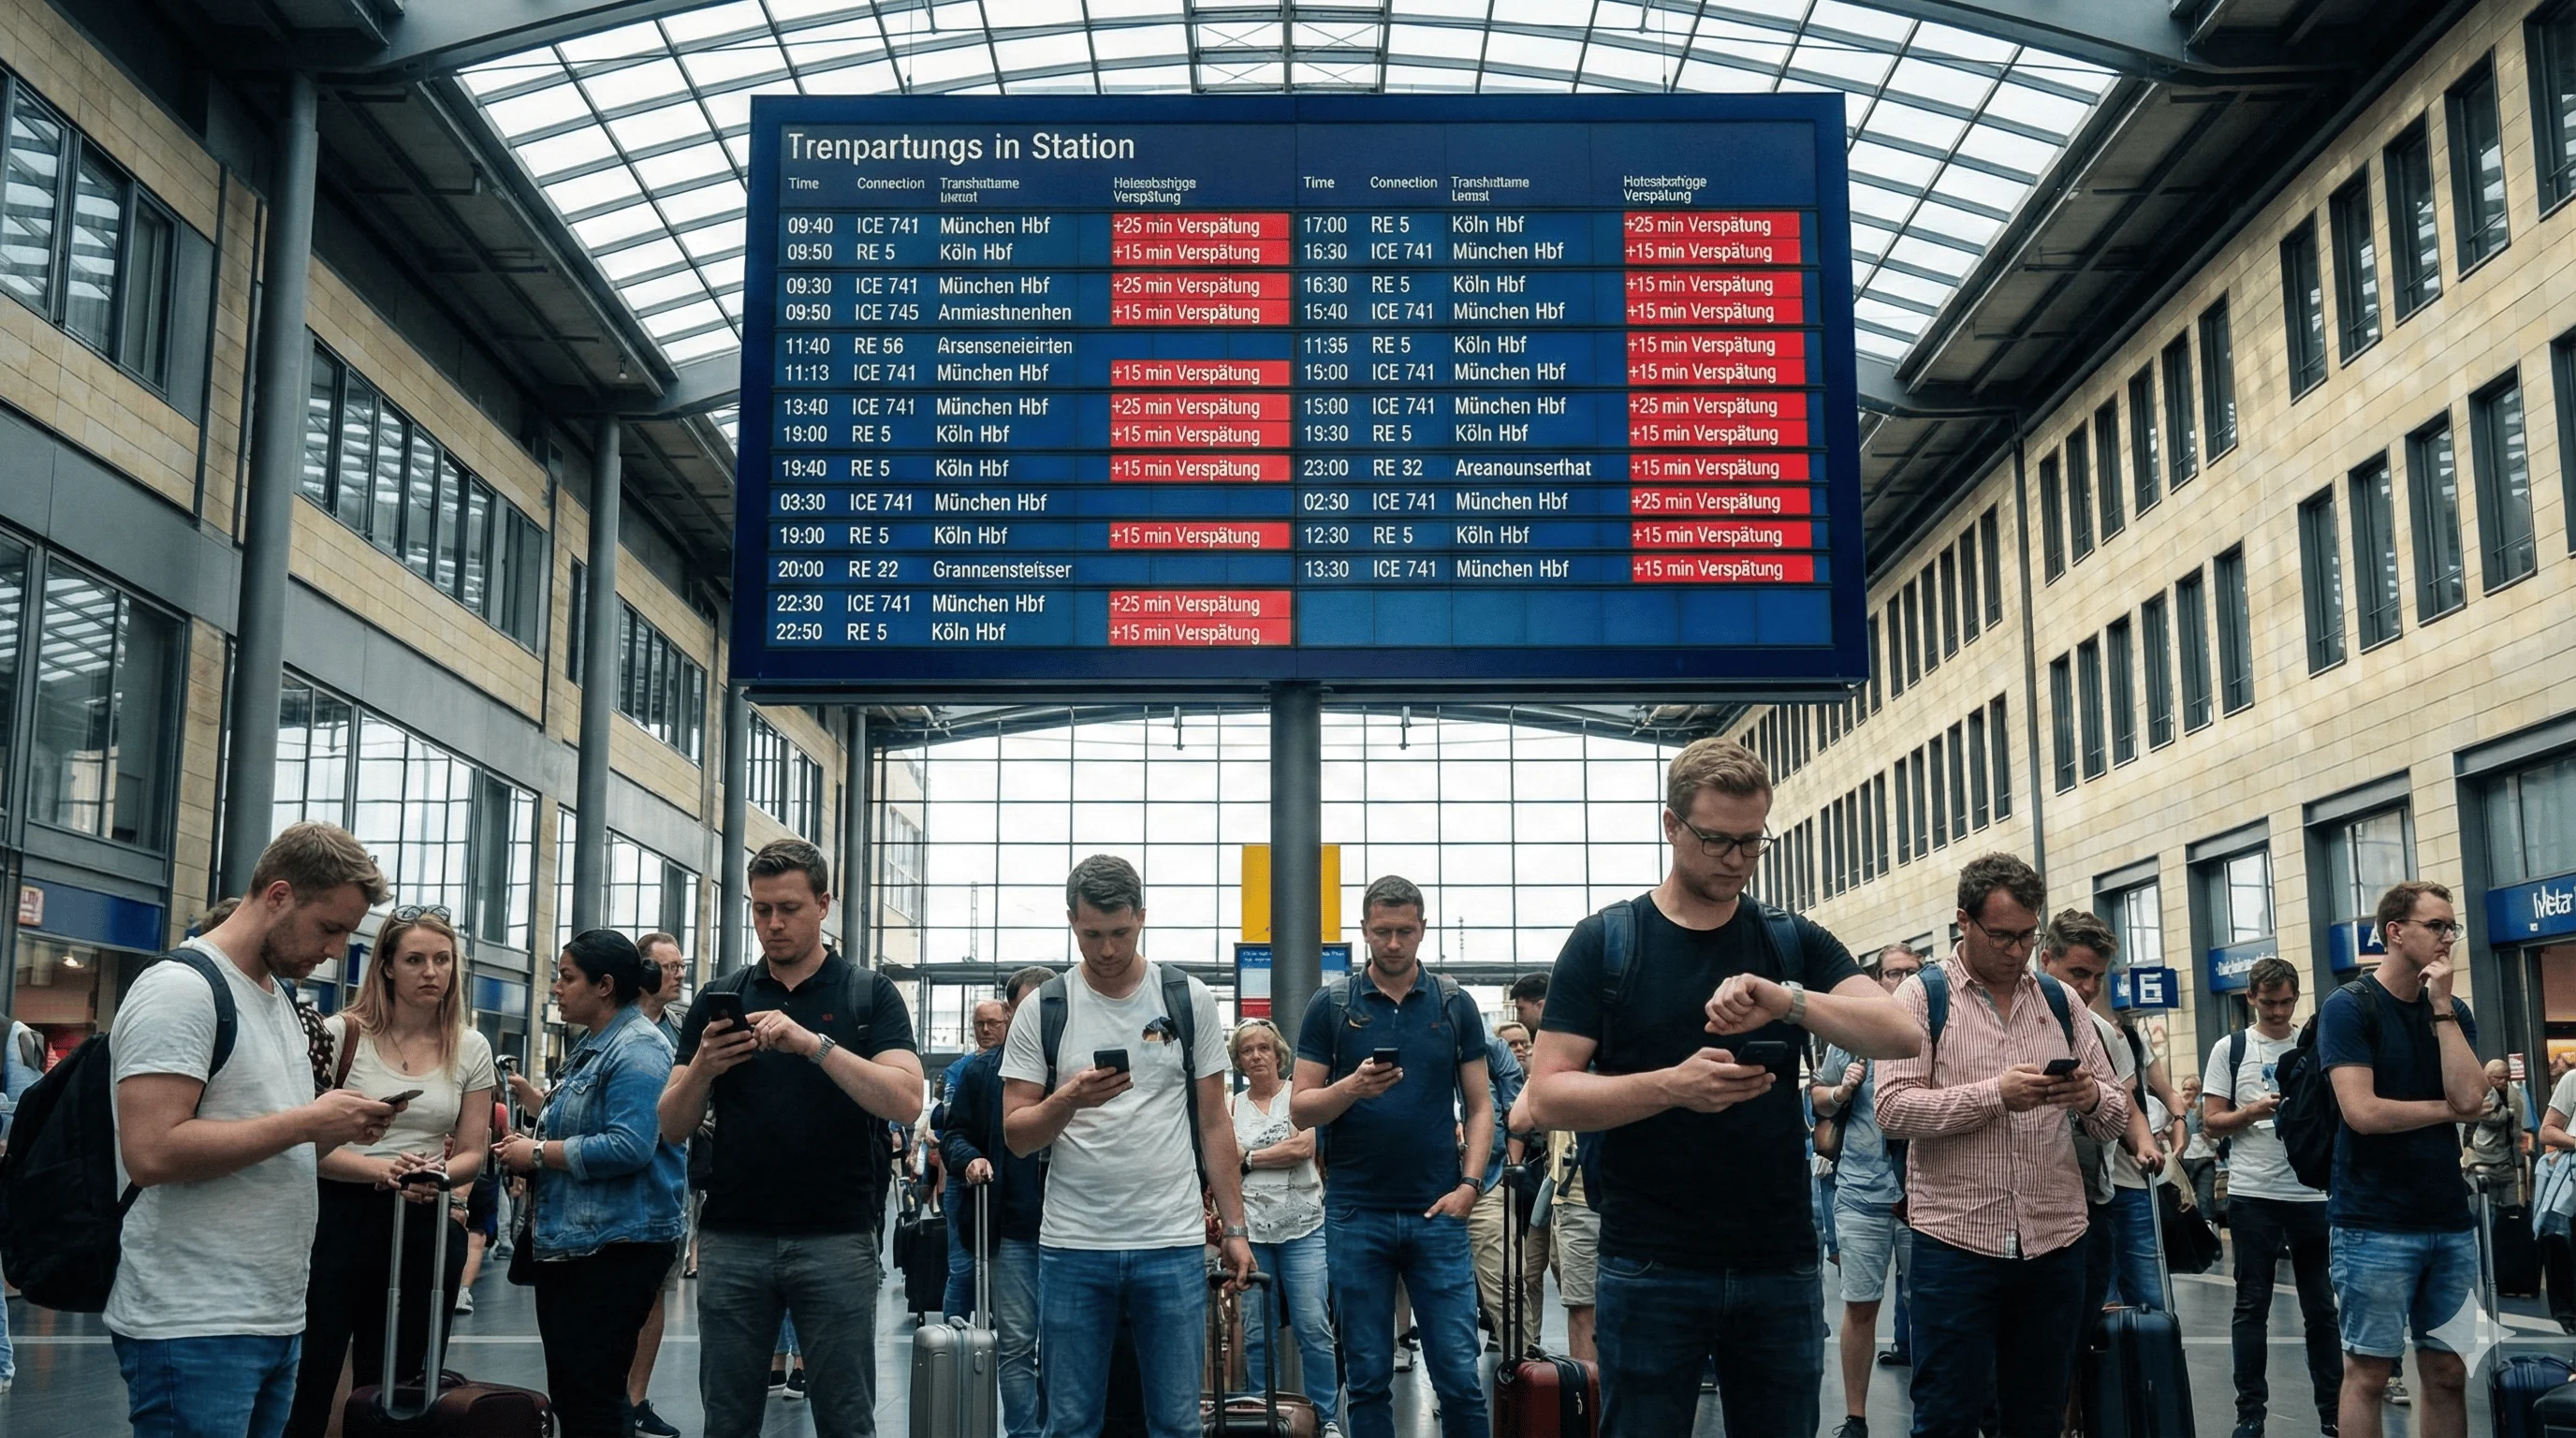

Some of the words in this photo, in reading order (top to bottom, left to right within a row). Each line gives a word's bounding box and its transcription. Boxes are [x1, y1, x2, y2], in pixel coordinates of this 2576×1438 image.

[788, 133, 983, 166] Trenpartungs
[995, 132, 1019, 159] in
[1032, 132, 1134, 160] Station
[788, 177, 819, 191] Time
[856, 177, 925, 190] Connection
[1303, 176, 1336, 189] Time
[1369, 175, 1439, 189] Connection
[787, 216, 833, 234] 09:40
[857, 216, 885, 234] ICE
[889, 216, 918, 234] 741
[941, 216, 1015, 234] München
[1021, 215, 1051, 234] Hbf
[1113, 216, 1142, 234] +25
[1146, 217, 1173, 234] min
[1177, 216, 1260, 239] Verspätung
[1304, 216, 1347, 233] 17:00
[1371, 215, 1394, 233] RE
[1399, 216, 1410, 233] 5
[1453, 214, 1489, 233] Köln
[1496, 215, 1525, 233] Hbf
[1624, 215, 1654, 233] +25
[1657, 215, 1684, 233] min
[1688, 215, 1772, 237] Verspätung
[786, 277, 832, 295] 09:30
[856, 277, 883, 294] ICE
[888, 277, 917, 295] 741
[939, 276, 1015, 294] München
[1020, 275, 1050, 294] Hbf
[1112, 276, 1142, 294] +25
[1145, 276, 1173, 294] min
[1176, 276, 1260, 299] Verspätung
[1304, 276, 1348, 294] 16:30
[1371, 275, 1395, 293] RE
[1400, 275, 1411, 293] 5
[1453, 274, 1490, 293] Köln
[1497, 274, 1526, 293] Hbf
[1626, 275, 1656, 293] +15
[1659, 274, 1686, 292] min
[1689, 274, 1774, 297] Verspätung
[785, 303, 831, 321] 09:50
[855, 303, 883, 321] ICE
[887, 303, 919, 321] 745
[1112, 303, 1142, 320] +15
[1146, 303, 1172, 320] min
[1176, 302, 1261, 325] Verspätung
[1371, 302, 1399, 320] ICE
[1404, 302, 1433, 319] 741
[1454, 301, 1530, 320] München
[1535, 301, 1565, 320] Hbf
[1627, 301, 1657, 319] +15
[1660, 301, 1687, 319] min
[1690, 301, 1775, 324] Verspätung
[785, 337, 830, 355] 11:40
[855, 337, 877, 355] RE
[883, 337, 904, 355] 56
[785, 363, 829, 381] 11:13
[854, 363, 881, 381] ICE
[886, 364, 915, 381] 741
[937, 362, 1013, 382] München
[1019, 363, 1049, 382] Hbf
[1112, 363, 1142, 381] +15
[1145, 364, 1172, 381] min
[1176, 363, 1261, 385] Verspätung
[783, 398, 828, 416] 13:40
[853, 398, 879, 416] ICE
[886, 398, 915, 415] 741
[936, 397, 1012, 416] München
[1019, 397, 1049, 416] Hbf
[1111, 397, 1141, 415] +25
[1145, 397, 1172, 415] min
[1176, 397, 1261, 419] Verspätung
[1304, 424, 1349, 442] 19:30
[1372, 424, 1396, 443] RE
[1401, 424, 1412, 442] 5
[1456, 423, 1492, 442] Köln
[1499, 423, 1529, 442] Hbf
[1630, 424, 1660, 442] +15
[1662, 424, 1690, 442] min
[1693, 424, 1778, 446] Verspätung
[782, 459, 827, 477] 19:40
[851, 459, 873, 477] RE
[880, 460, 890, 477] 5
[935, 458, 973, 477] Köln
[979, 459, 1009, 477] Hbf
[1111, 459, 1141, 477] +15
[1145, 459, 1172, 477] min
[1175, 459, 1261, 481] Verspätung
[1303, 459, 1349, 477] 23:00
[1373, 459, 1396, 477] RE
[1402, 459, 1423, 477] 32
[1631, 459, 1661, 477] +15
[1663, 458, 1691, 476] min
[1694, 458, 1780, 480] Verspätung
[780, 492, 826, 511] 03:30
[850, 492, 878, 511] ICE
[883, 493, 912, 511] 741
[935, 492, 1011, 511] München
[1017, 492, 1047, 511] Hbf
[780, 526, 825, 545] 19:00
[849, 526, 872, 544] RE
[878, 527, 889, 544] 5
[934, 525, 972, 545] Köln
[978, 526, 1008, 545] Hbf
[1110, 526, 1141, 544] +15
[1144, 526, 1172, 544] min
[1175, 526, 1261, 549] Verspätung
[1305, 526, 1349, 544] 12:30
[1373, 525, 1397, 544] RE
[1403, 526, 1413, 544] 5
[1456, 525, 1494, 544] Köln
[1500, 525, 1530, 544] Hbf
[1632, 526, 1662, 543] +15
[1665, 525, 1693, 543] min
[1696, 525, 1783, 548] Verspätung
[778, 560, 824, 578] 20:00
[848, 560, 871, 578] RE
[877, 560, 899, 578] 22
[1305, 560, 1350, 578] 13:30
[1373, 559, 1401, 578] ICE
[1406, 560, 1436, 578] 741
[1456, 559, 1533, 578] München
[1540, 559, 1570, 578] Hbf
[1632, 559, 1663, 578] +15
[1666, 559, 1694, 577] min
[1697, 559, 1783, 581] Verspätung
[777, 594, 824, 612] 22:30
[847, 594, 875, 612] ICE
[881, 594, 910, 612] 741
[932, 594, 1009, 612] München
[1016, 594, 1046, 612] Hbf
[1110, 594, 1140, 612] +25
[1144, 594, 1172, 612] min
[1175, 594, 1261, 616] Verspätung
